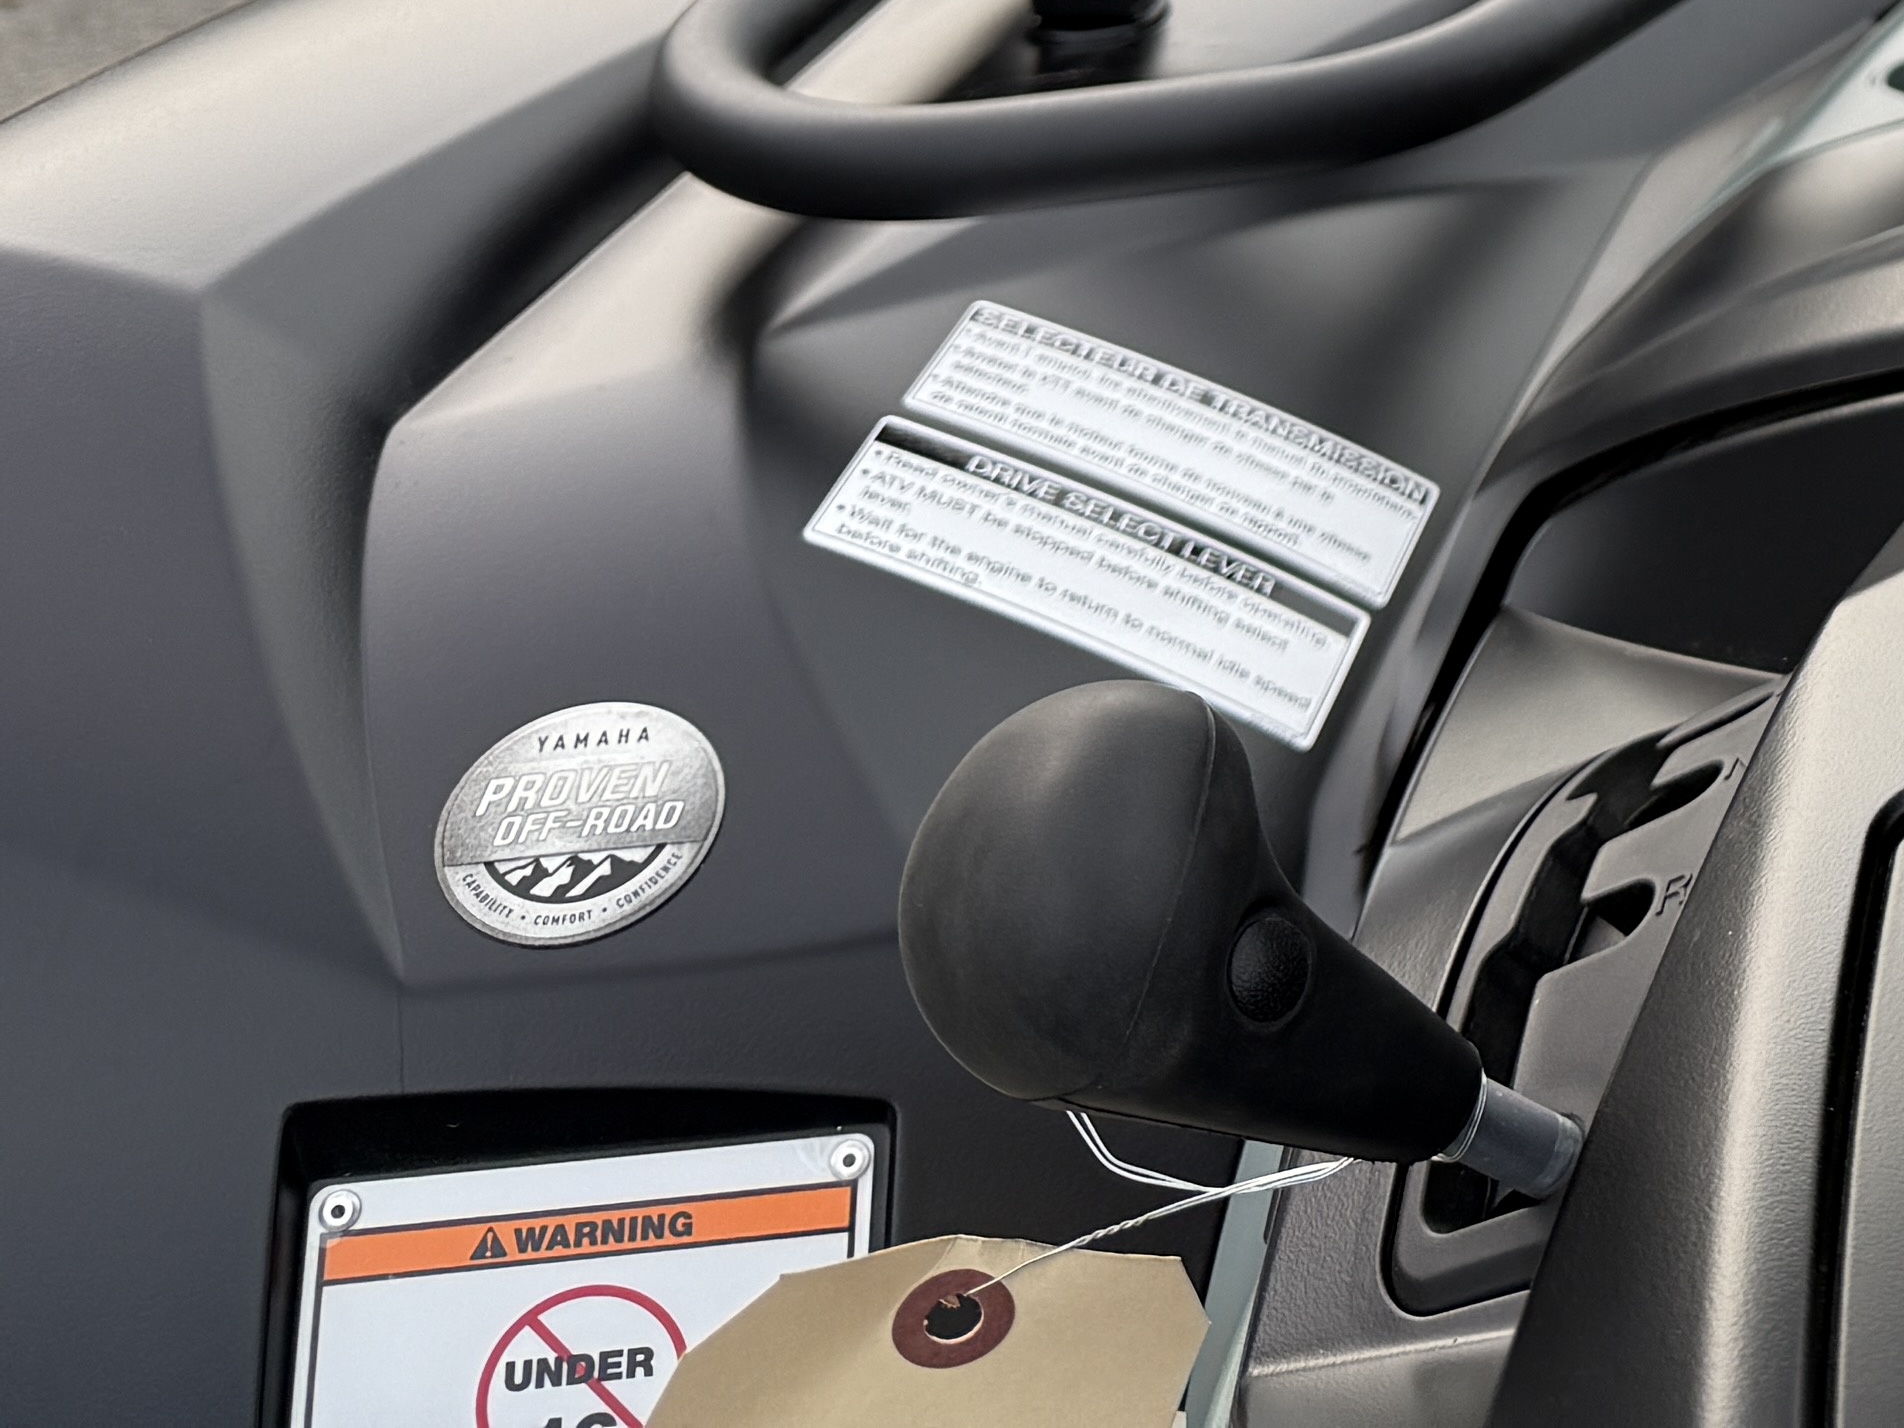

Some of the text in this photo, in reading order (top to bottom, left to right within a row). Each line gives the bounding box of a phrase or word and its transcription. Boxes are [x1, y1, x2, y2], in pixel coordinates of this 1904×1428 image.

[868, 467, 914, 495] ATV
[912, 483, 980, 522] MUST
[895, 522, 926, 544] for
[927, 534, 964, 559] the
[966, 454, 1062, 502] DRIVE
[1062, 491, 1175, 549] SELECT
[1183, 540, 1276, 595] LEVER
[538, 727, 649, 753] YAMAHA
[475, 760, 673, 817] PROVEN
[493, 800, 686, 846] OFF-ROAD
[461, 853, 683, 926] CAPABILITY COMFORT CONFIDENCE
[514, 1211, 693, 1254] WARNING
[504, 1346, 654, 1392] UNDER
